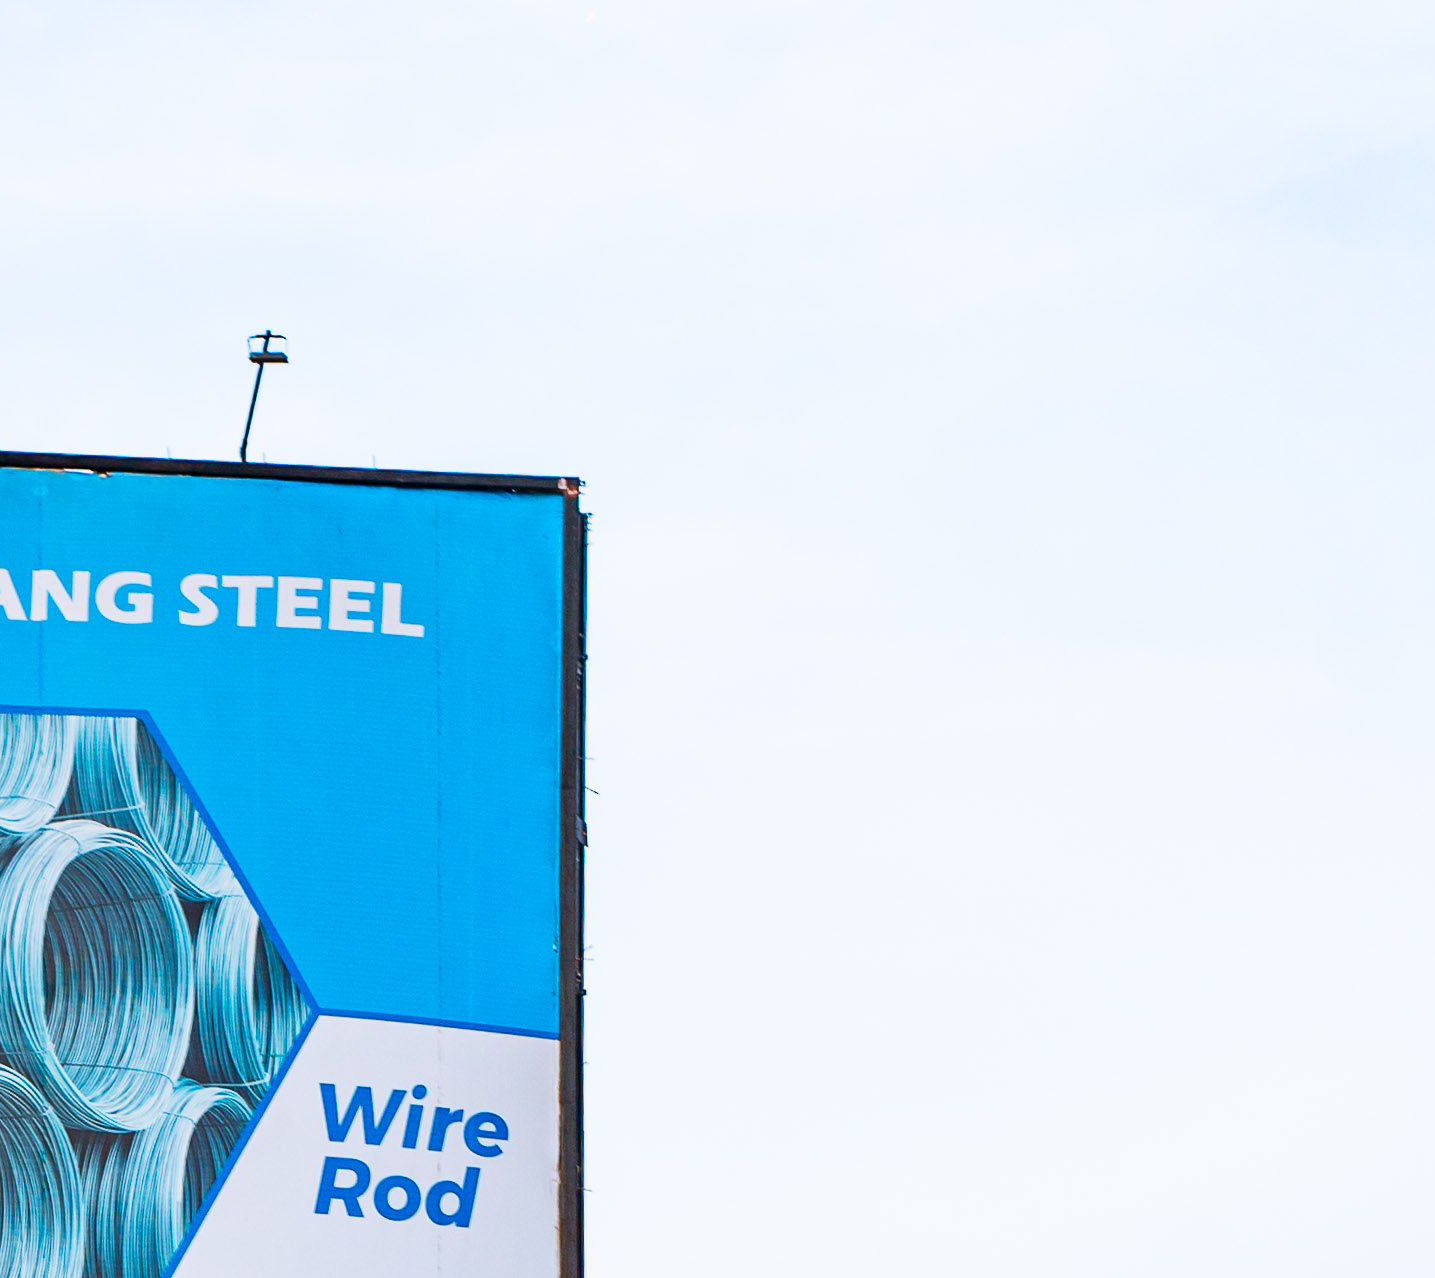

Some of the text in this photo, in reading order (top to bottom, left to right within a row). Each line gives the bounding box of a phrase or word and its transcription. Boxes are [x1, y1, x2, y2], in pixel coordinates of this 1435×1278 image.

[179, 572, 425, 639] STEEL
[319, 1082, 509, 1158] Wire
[314, 1156, 481, 1228] Rod
